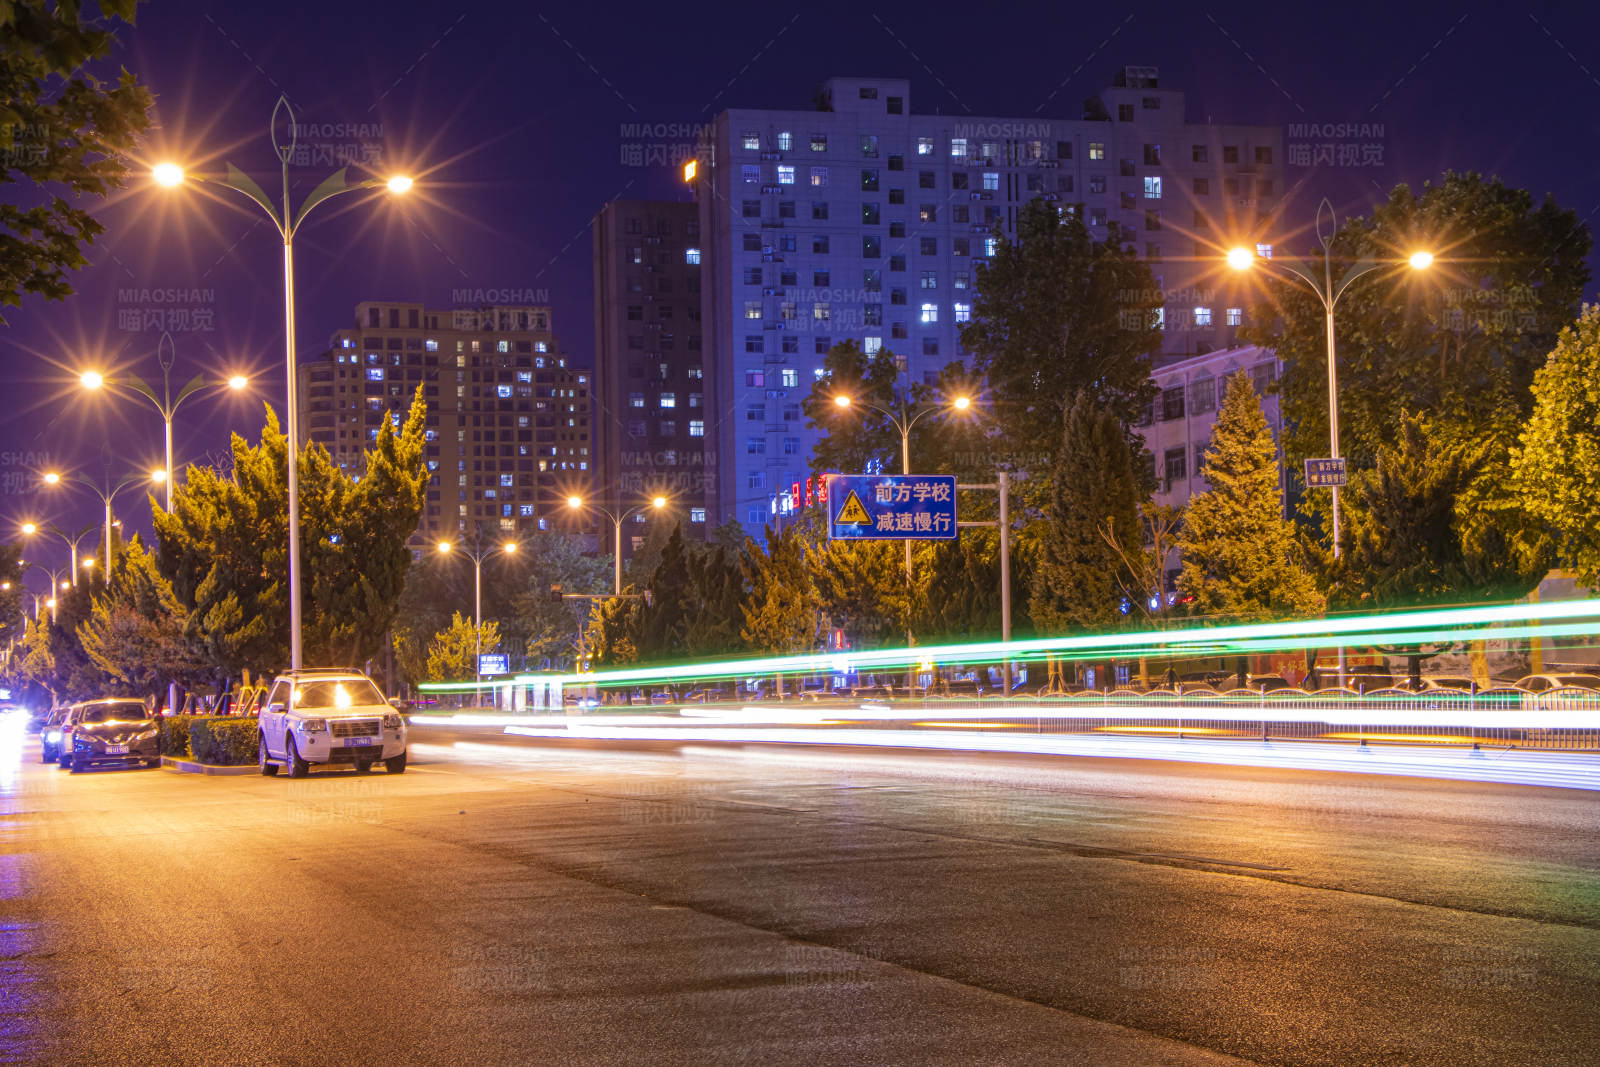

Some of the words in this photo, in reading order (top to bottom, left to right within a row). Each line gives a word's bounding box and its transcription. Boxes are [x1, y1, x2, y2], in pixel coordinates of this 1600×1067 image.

[875, 482, 951, 502] 前方学校
[876, 511, 951, 532] 减速慢行
